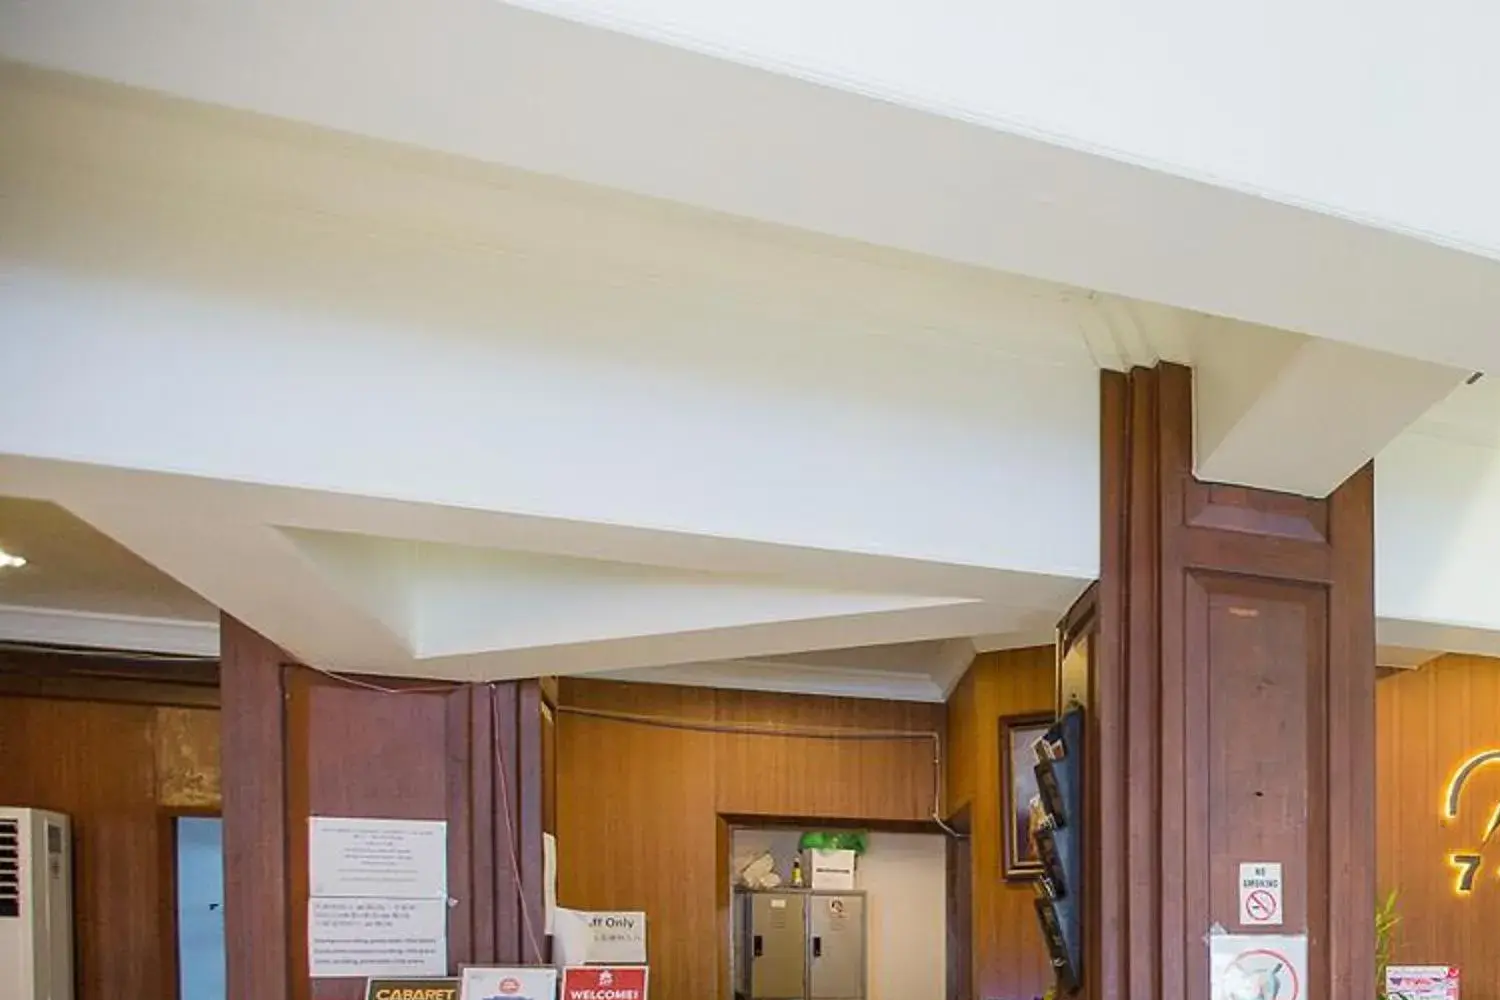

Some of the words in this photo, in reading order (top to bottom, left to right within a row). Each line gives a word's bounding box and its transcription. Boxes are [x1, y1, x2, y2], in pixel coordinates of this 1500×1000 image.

[1255, 867, 1265, 877] NO
[1452, 854, 1482, 892] 7
[1243, 879, 1278, 888] SMOKING
[606, 917, 635, 930] Only
[570, 989, 639, 1000] WELCOME!
